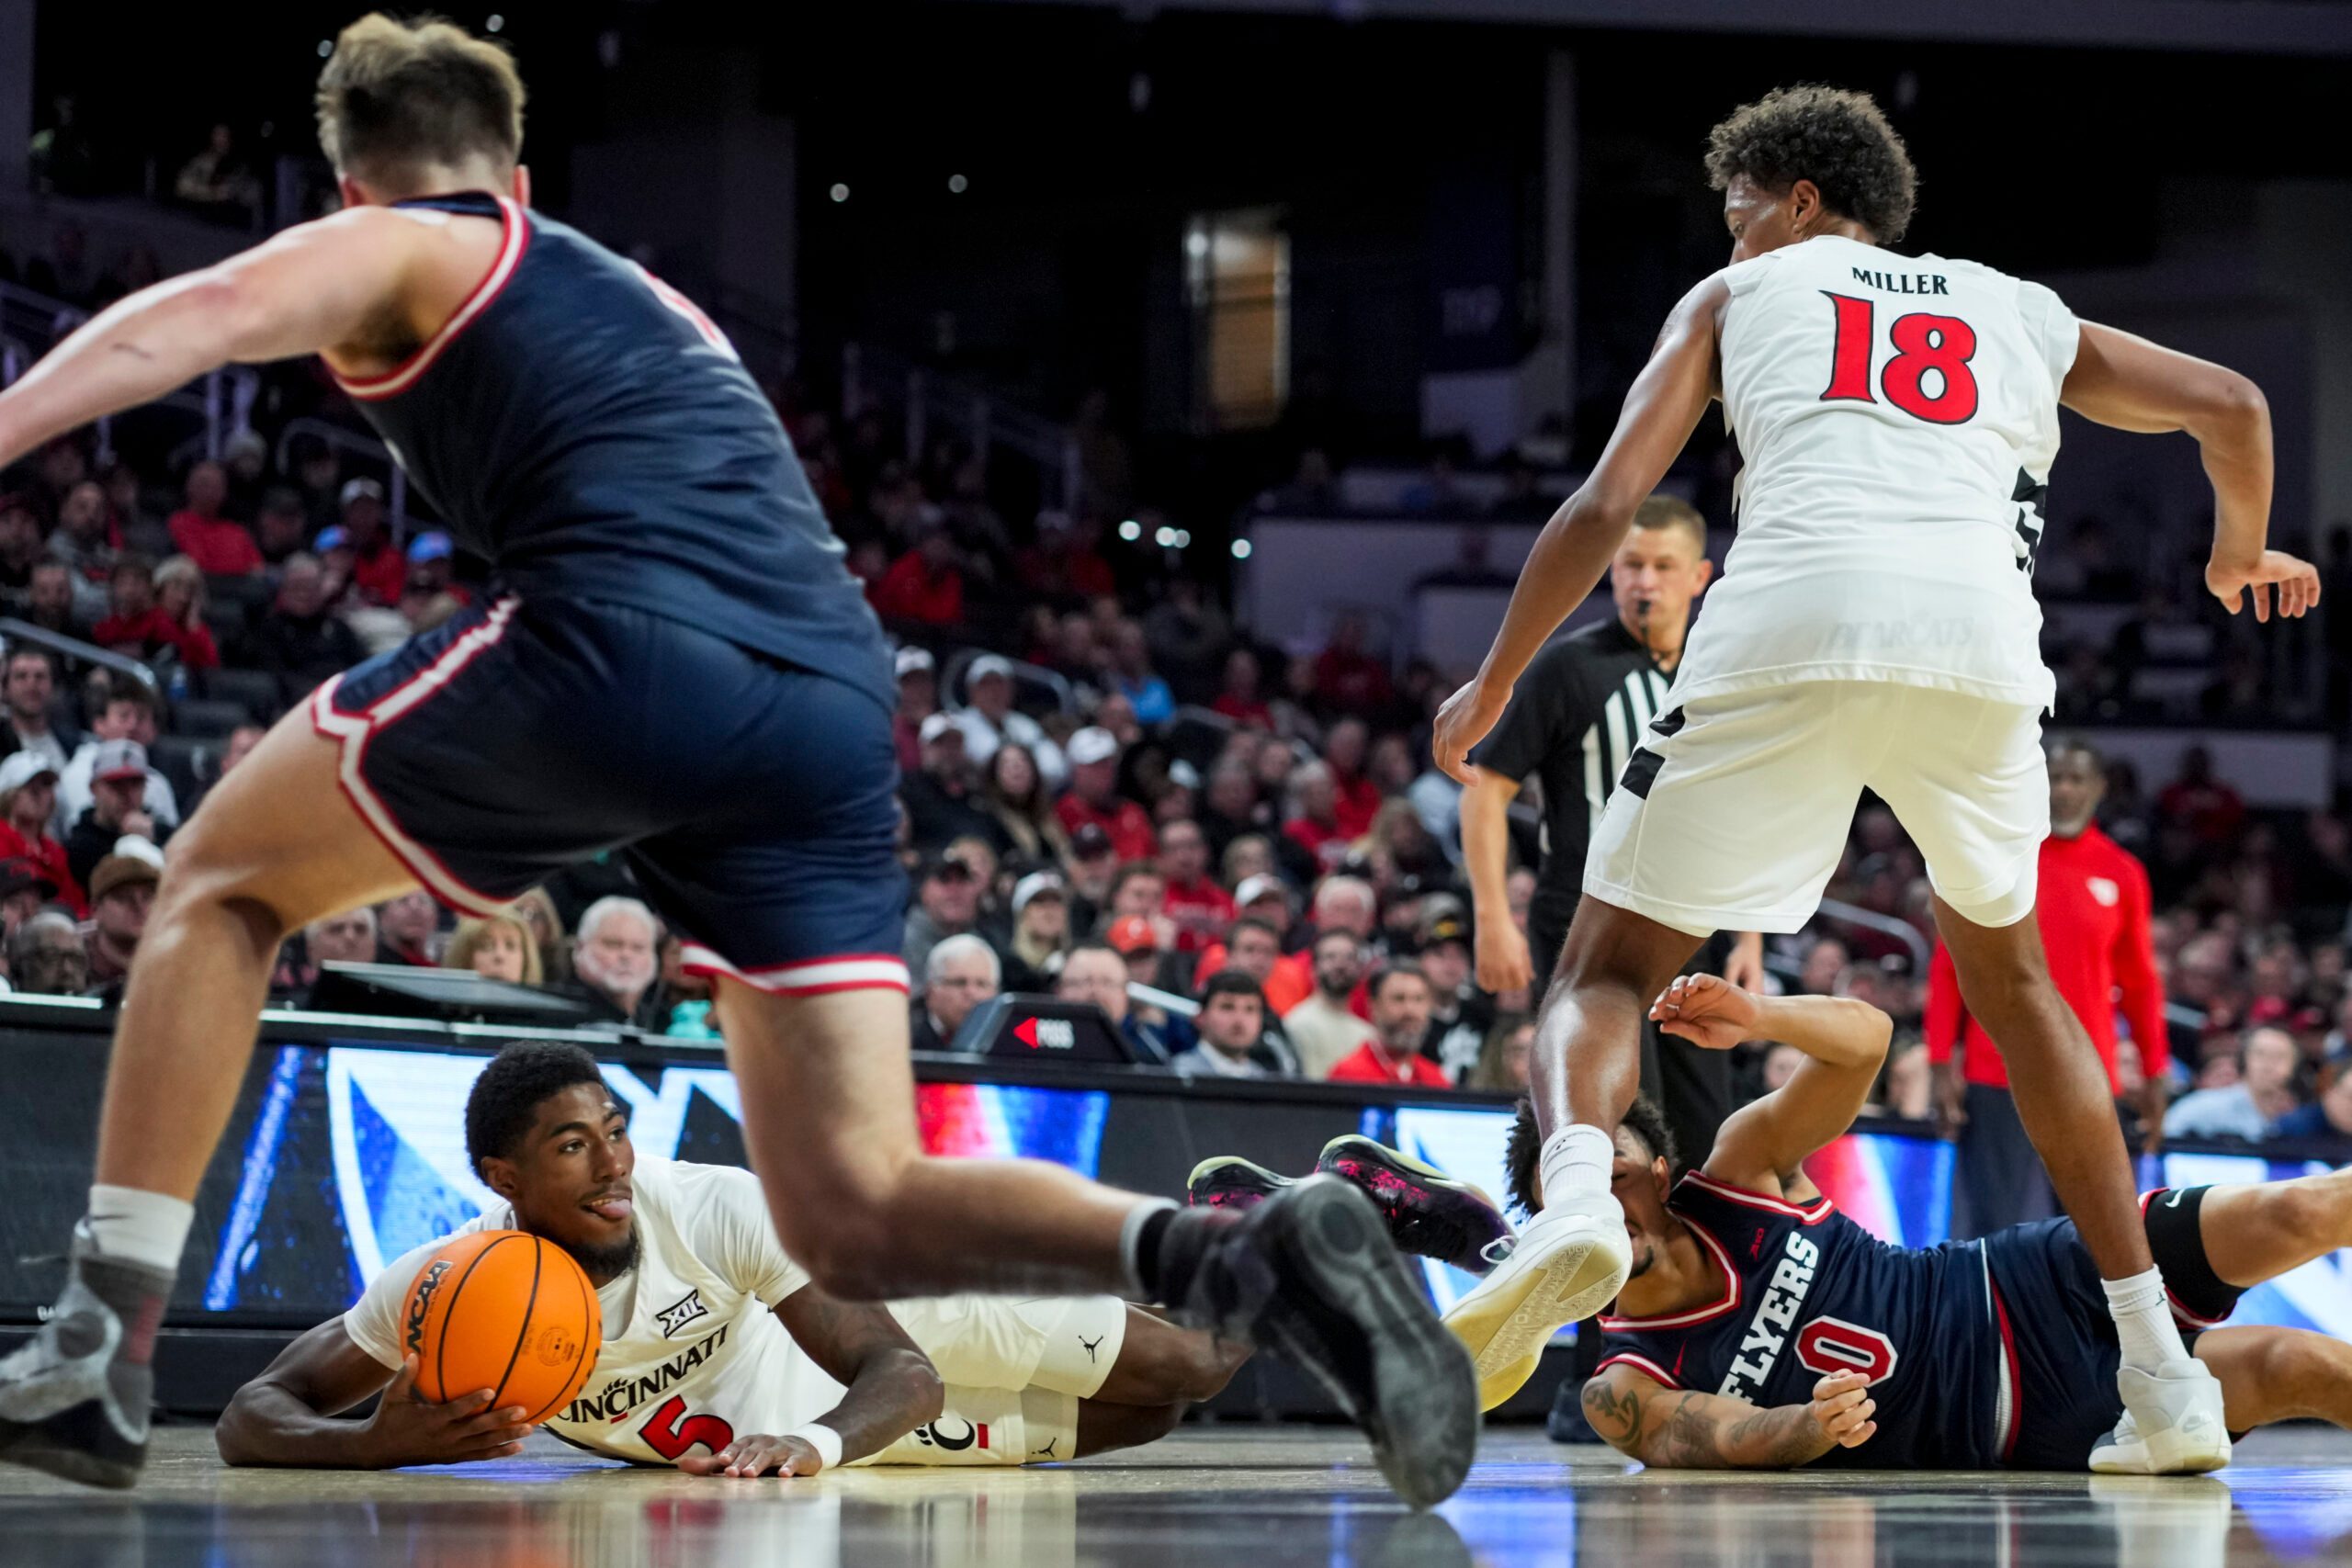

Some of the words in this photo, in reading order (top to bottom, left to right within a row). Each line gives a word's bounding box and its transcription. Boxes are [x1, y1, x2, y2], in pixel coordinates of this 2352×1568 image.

[1851, 265, 1950, 296] MILLER
[1819, 290, 1978, 424] 18
[406, 1259, 454, 1356] NCAA
[1716, 1231, 1820, 1405] FLYERS
[1793, 1314, 1899, 1388] 0
[639, 1393, 734, 1461] 5
